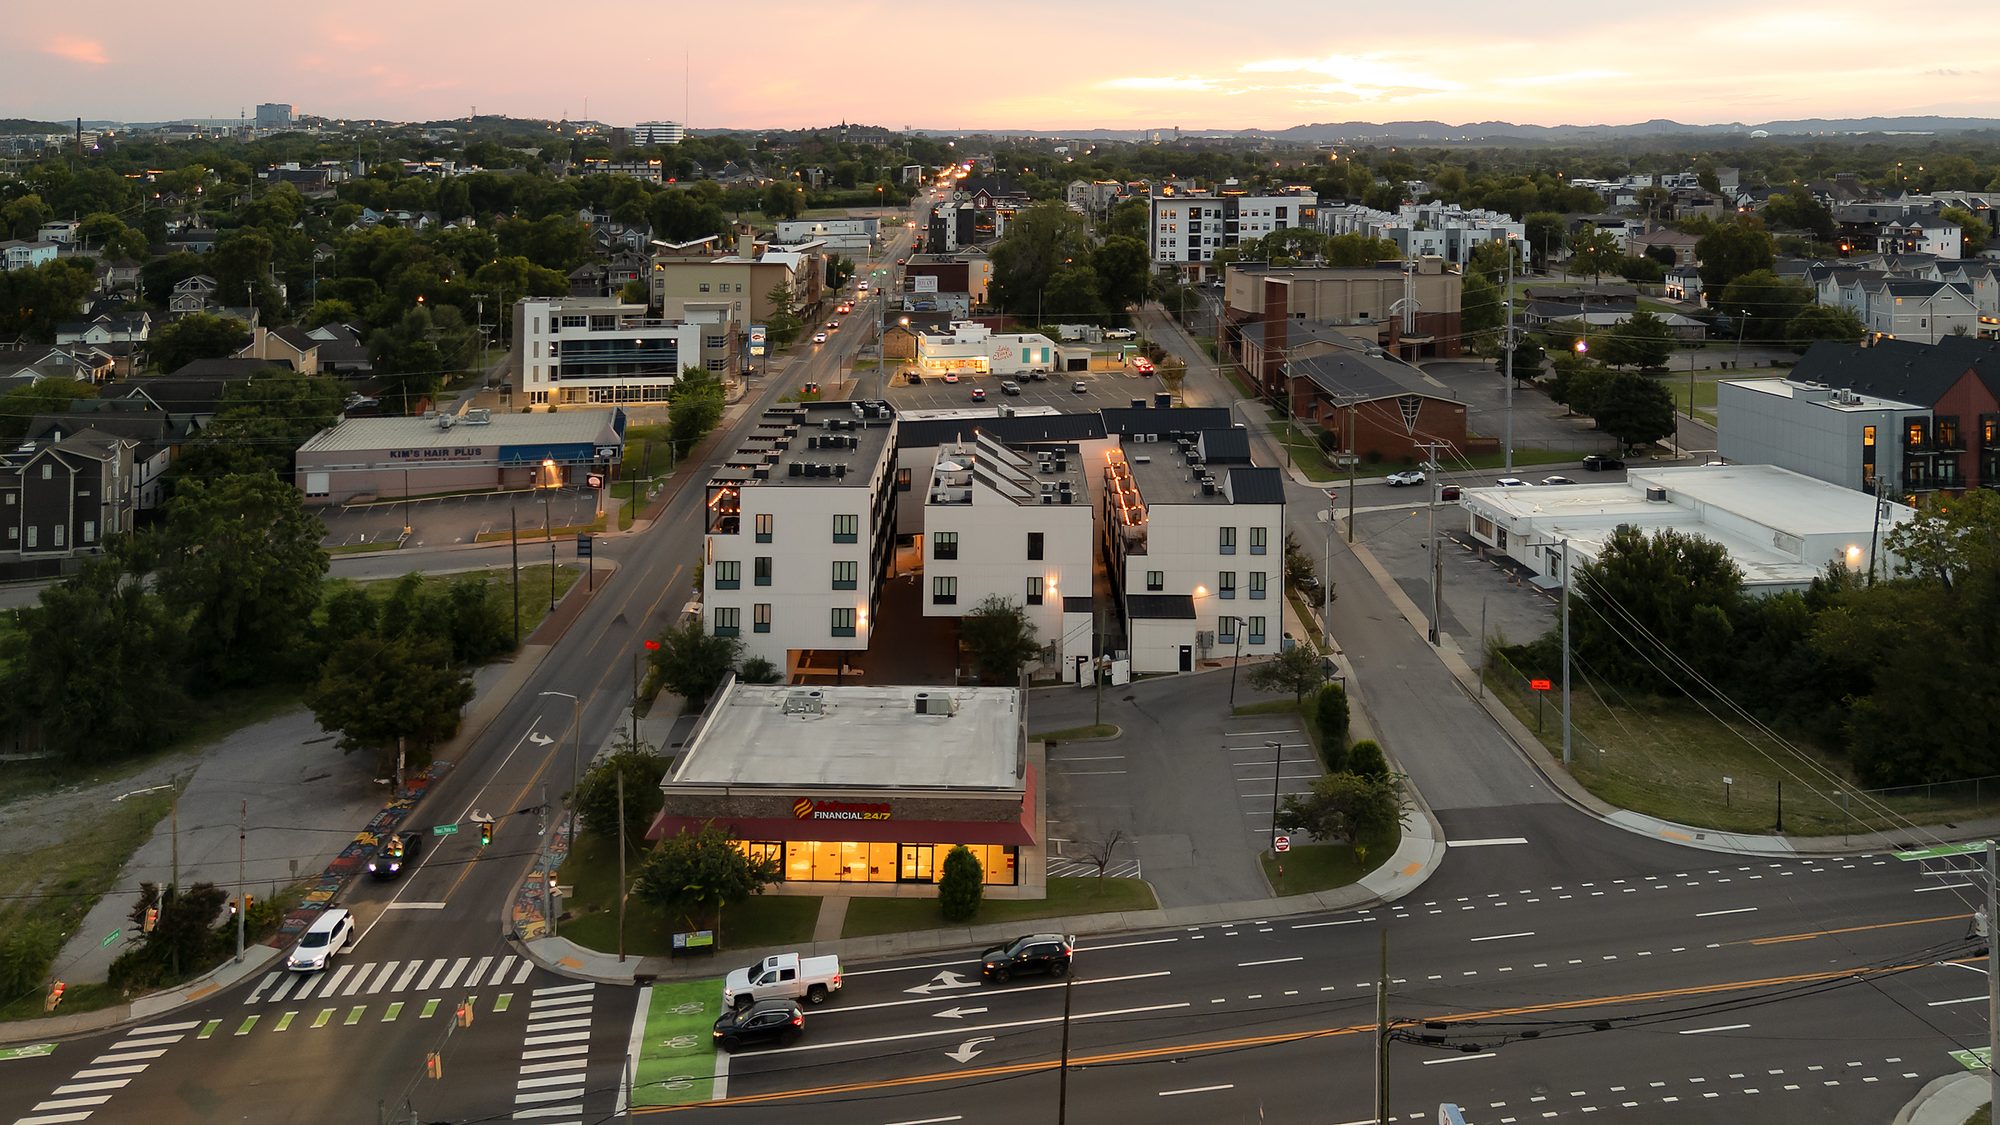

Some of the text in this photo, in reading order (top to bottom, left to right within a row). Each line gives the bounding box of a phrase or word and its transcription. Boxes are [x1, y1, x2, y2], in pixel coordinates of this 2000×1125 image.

[390, 448, 481, 458] KIM'S HAIR PLUS
[814, 811, 891, 820] FINANCIAL 24/7
